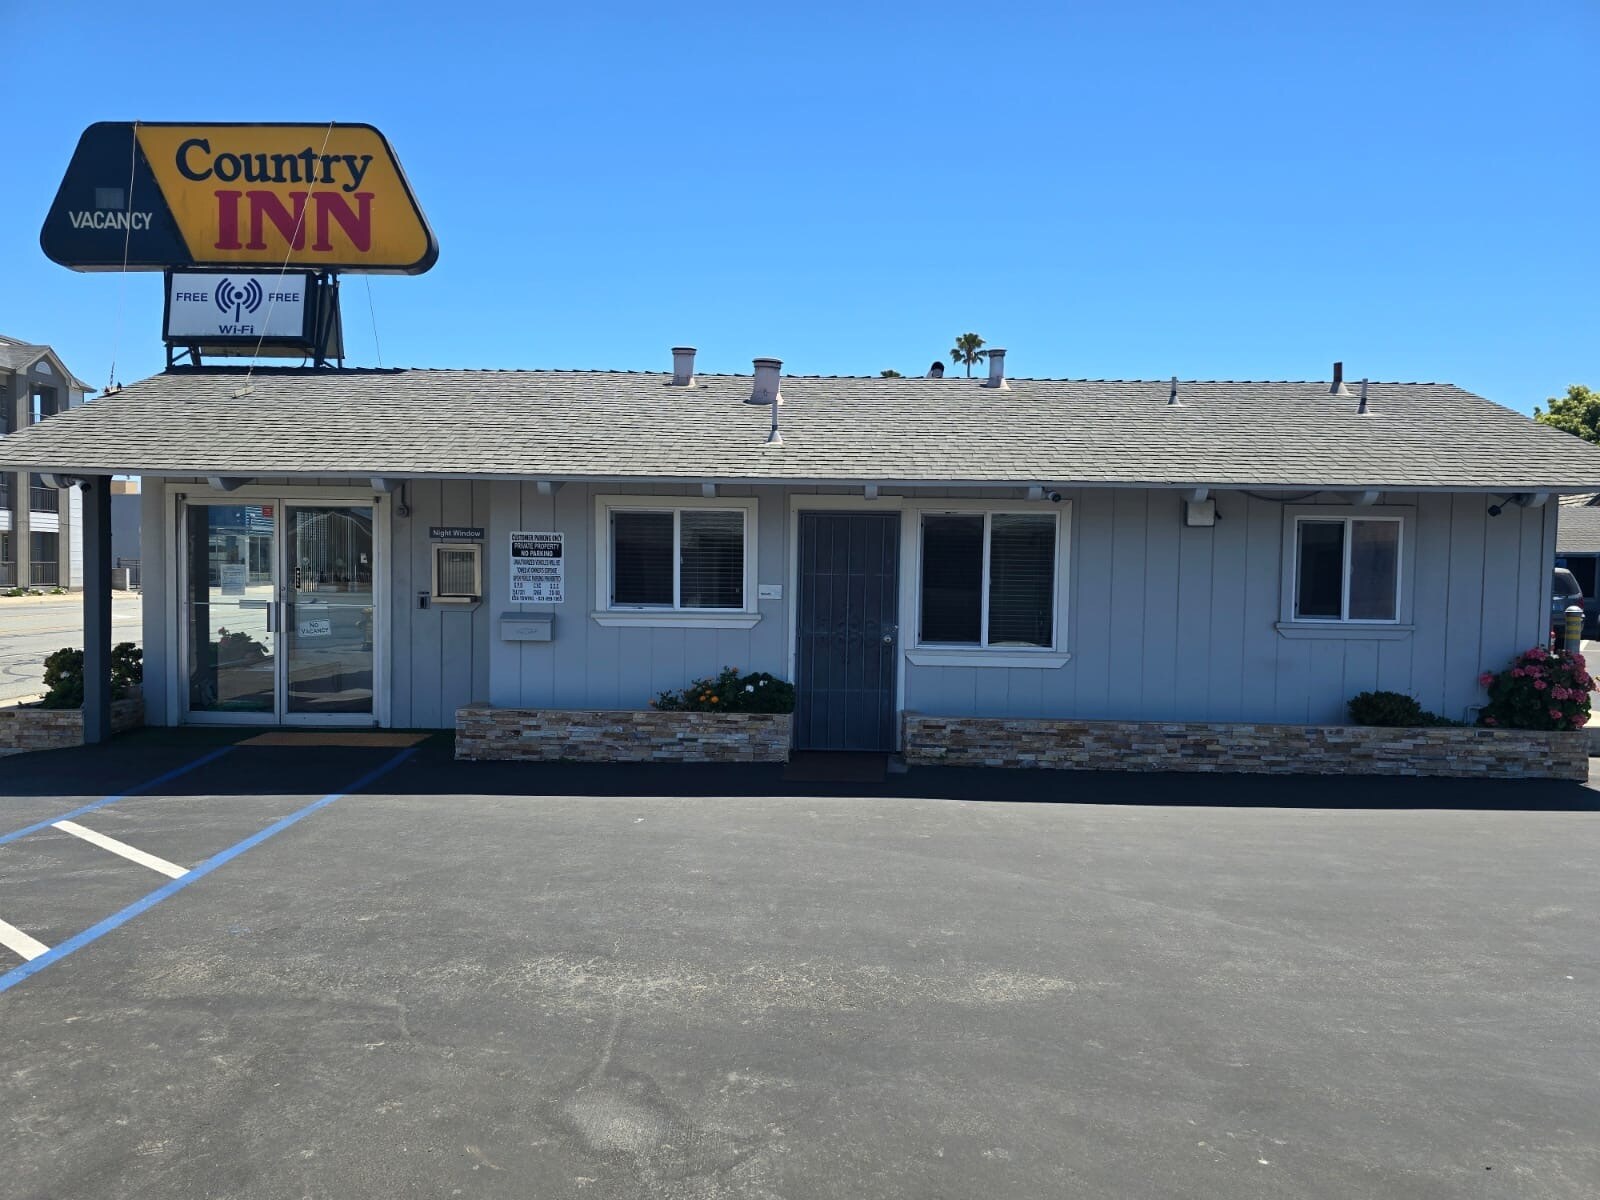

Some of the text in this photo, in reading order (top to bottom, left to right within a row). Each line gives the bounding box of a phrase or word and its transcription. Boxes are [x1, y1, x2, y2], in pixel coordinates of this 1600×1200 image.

[175, 138, 373, 193] Country
[68, 211, 153, 231] VACANCY
[214, 190, 375, 253] INN
[176, 292, 300, 302] FREE FREE
[218, 325, 254, 334] Wi-Fi
[432, 529, 481, 538] Night Window
[301, 627, 329, 635] VACANCY
